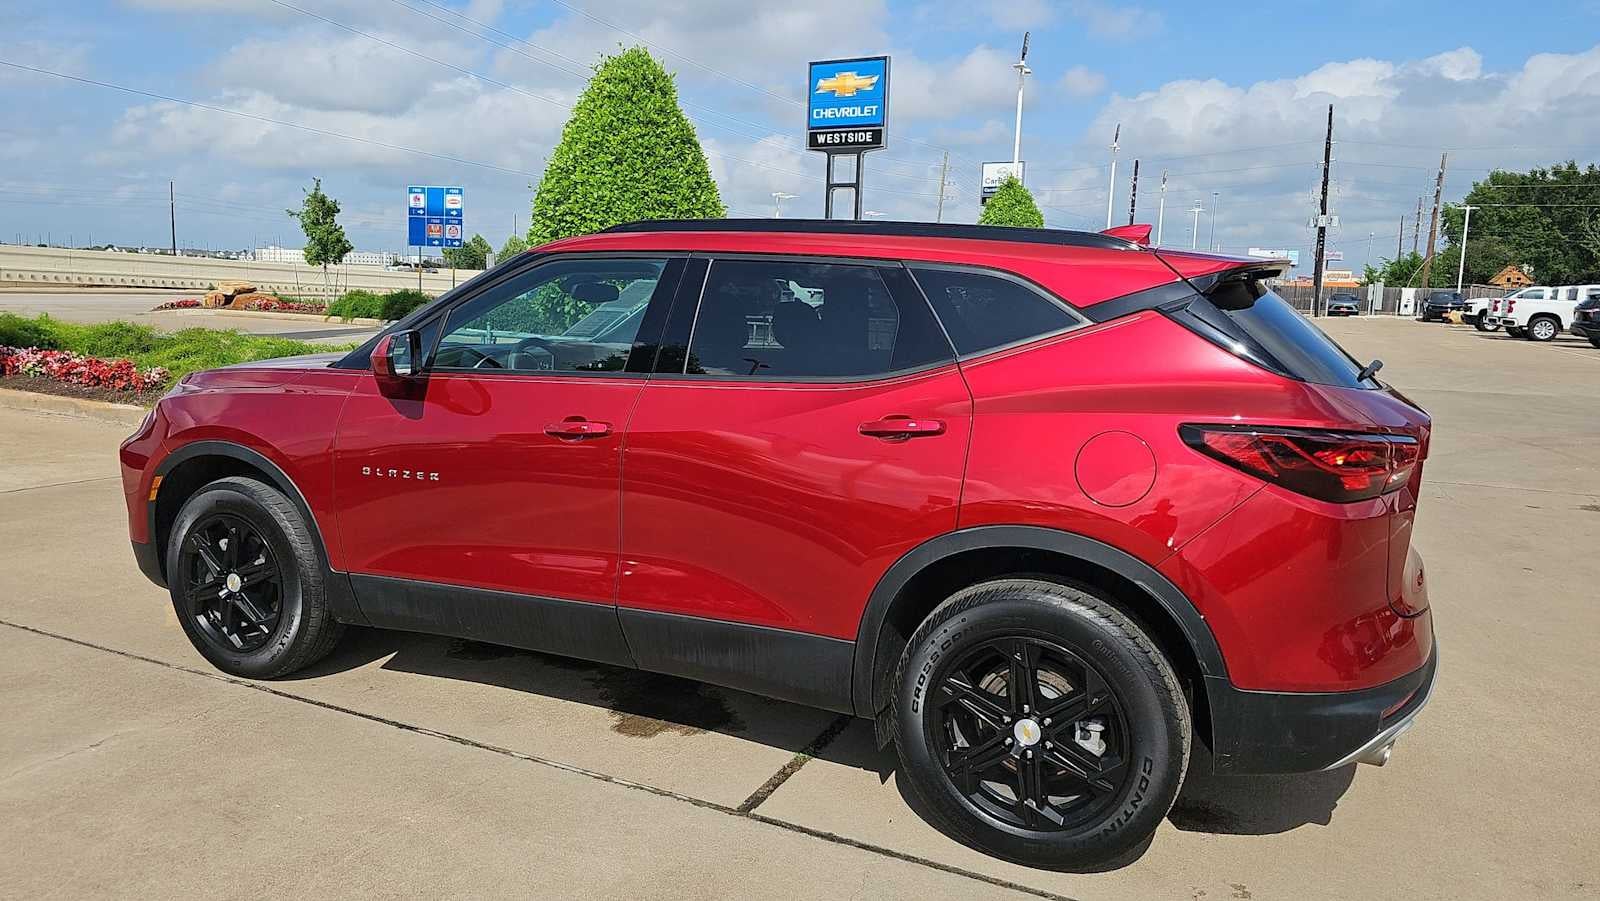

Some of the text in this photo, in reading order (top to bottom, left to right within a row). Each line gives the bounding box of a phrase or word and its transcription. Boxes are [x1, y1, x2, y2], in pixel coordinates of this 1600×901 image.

[813, 105, 878, 119] CHEVROLET
[816, 131, 873, 144] WESTSIDE
[362, 466, 439, 481] BLAZER
[912, 651, 940, 714] CROSS
